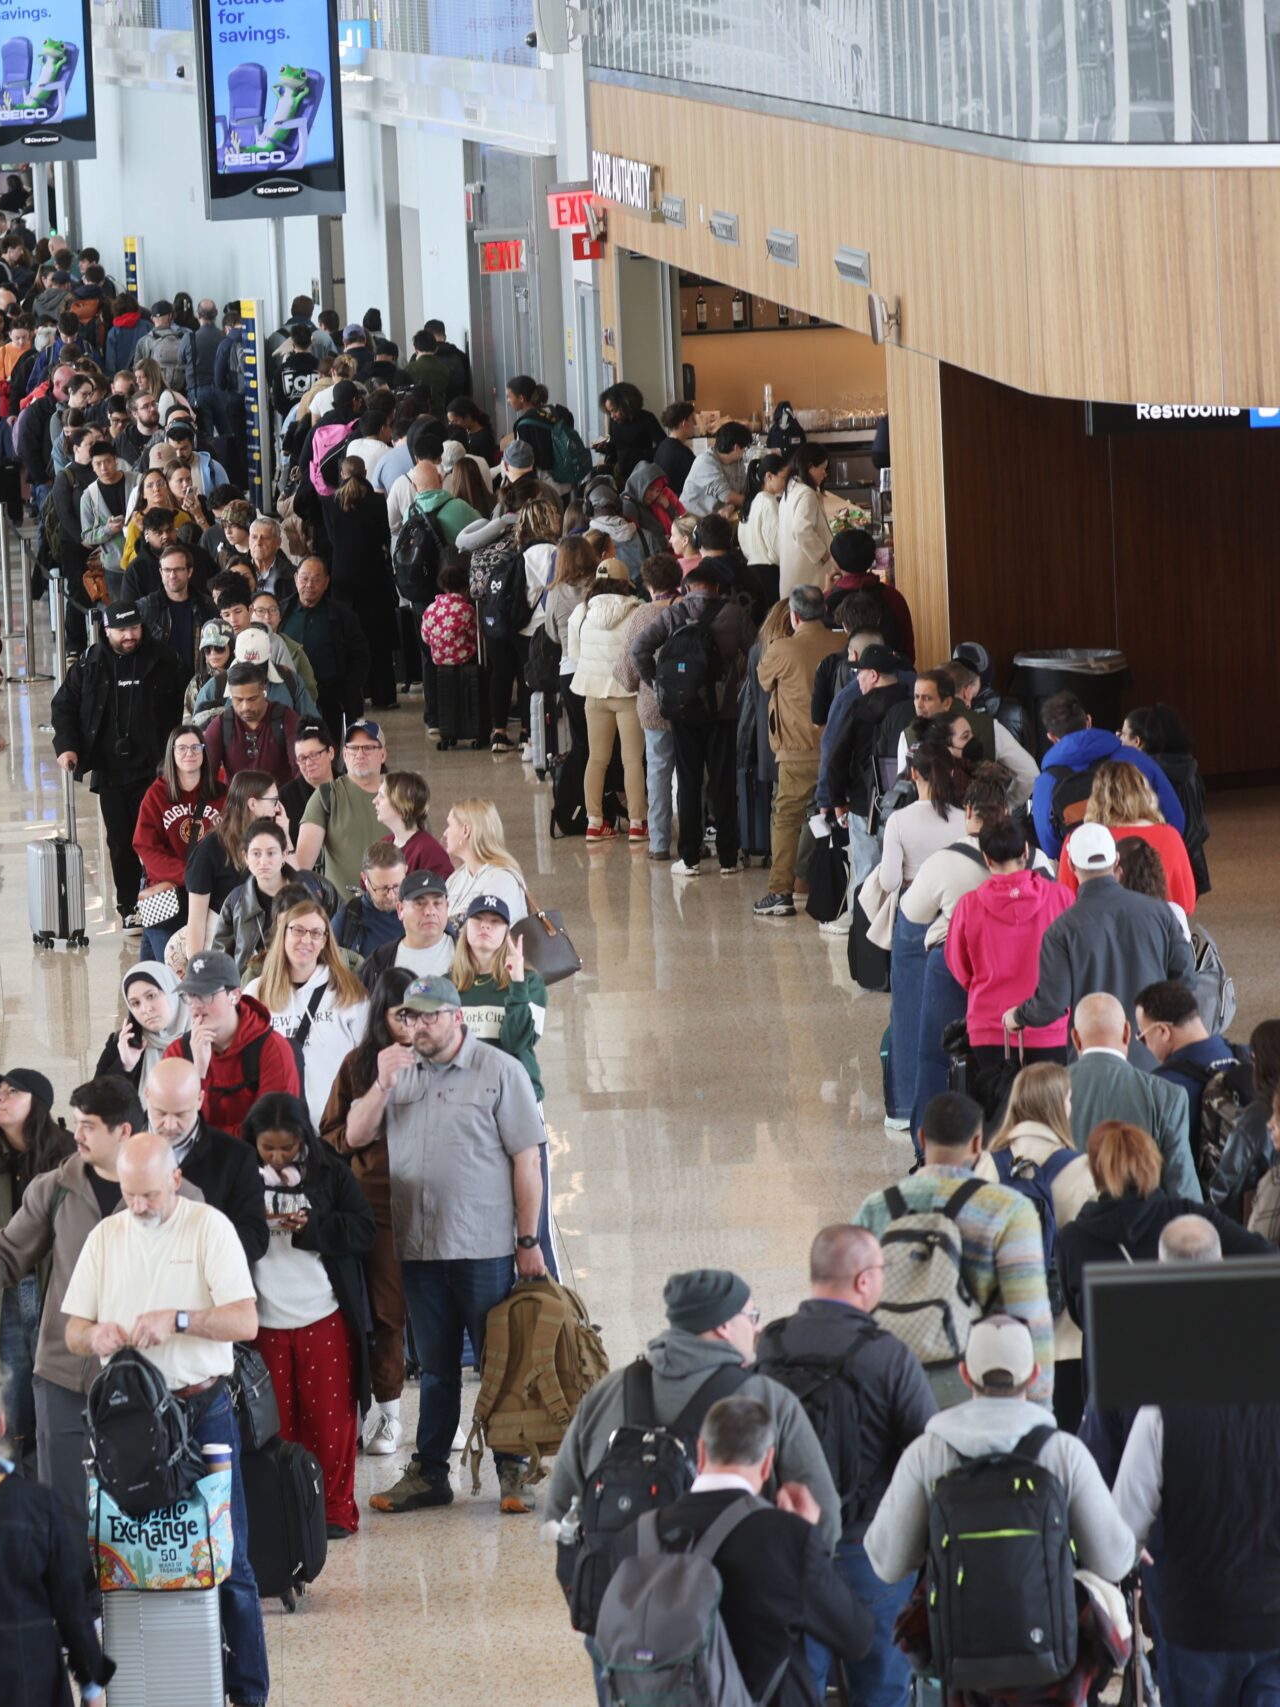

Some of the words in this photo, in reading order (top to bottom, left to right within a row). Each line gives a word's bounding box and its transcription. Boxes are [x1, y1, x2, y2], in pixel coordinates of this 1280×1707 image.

[217, 9, 245, 24] for
[219, 26, 290, 45] savings.
[225, 151, 287, 166] GEICO
[592, 151, 612, 199] POUR
[613, 156, 651, 210] AUTHORITY
[278, 186, 299, 194] Channel
[485, 240, 522, 271] EXIT
[107, 1515, 199, 1551] Exchange
[161, 1549, 177, 1561] 50
